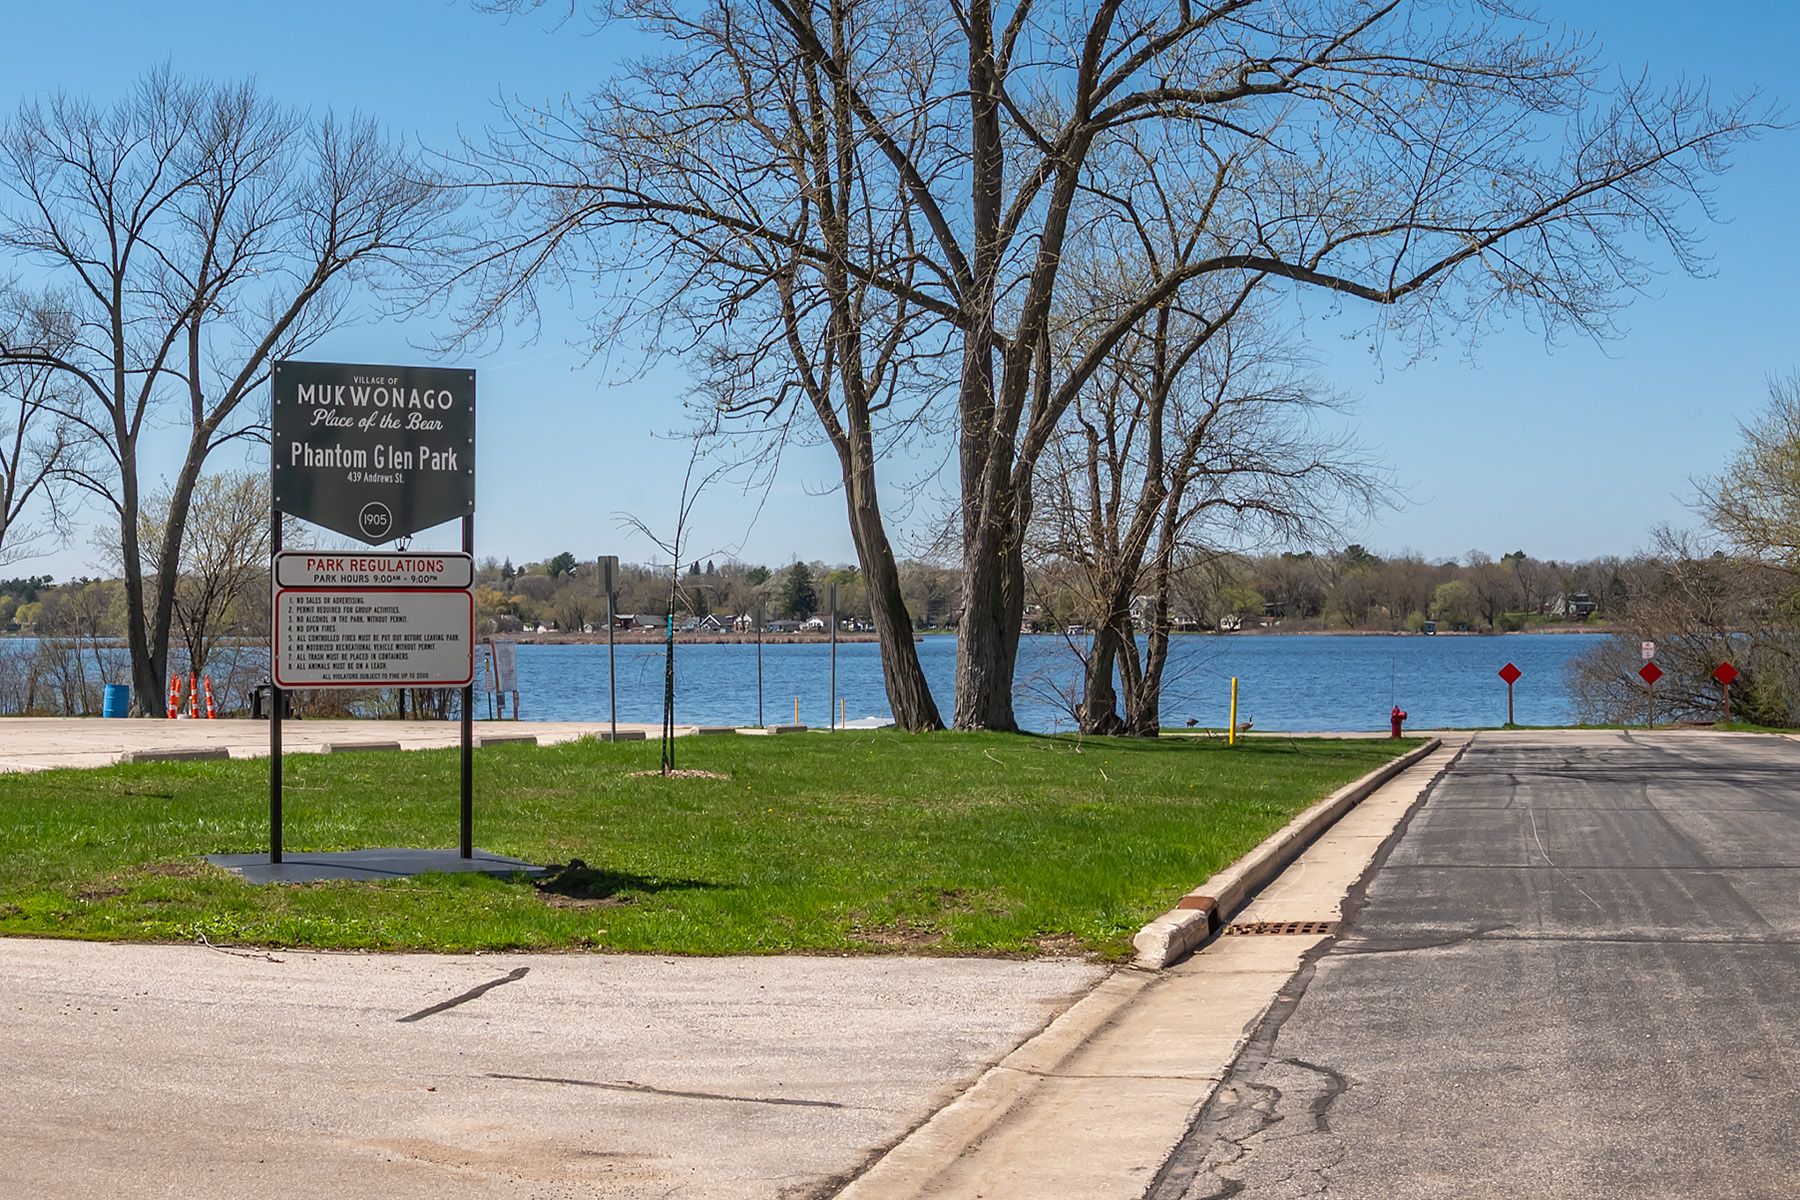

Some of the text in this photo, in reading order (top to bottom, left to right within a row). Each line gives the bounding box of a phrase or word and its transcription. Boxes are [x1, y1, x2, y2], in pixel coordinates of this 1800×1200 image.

[353, 376, 398, 385] VILLAGE OF
[297, 383, 453, 410] MUKWONAGO
[310, 408, 443, 432] Place of the Bear
[291, 441, 458, 471] Phantom Glen Park
[347, 471, 405, 484] 439 Andrews St.
[364, 514, 387, 526] 1905
[307, 558, 444, 573] PARK REGULATIONS
[313, 574, 337, 583] PARK
[340, 574, 370, 583] HOURS
[288, 606, 400, 614] 2. PERMIT REQUIRED FOR GROUP ACTIVITIES.
[288, 634, 294, 642] 5.
[296, 634, 306, 642] ALL
[308, 634, 340, 642] CONTROLLED
[342, 634, 356, 642] FIRES
[358, 634, 371, 642] MUST
[373, 634, 380, 642] BE
[381, 634, 391, 642] PUT
[393, 634, 402, 642] OUT
[404, 634, 422, 642] BEFORE
[424, 634, 444, 642] LEAVING
[296, 662, 306, 670] ALL
[308, 662, 331, 670] ANIMALS
[333, 662, 346, 670] MUST
[348, 662, 354, 670] BE
[356, 662, 363, 670] ON
[365, 662, 369, 670] A
